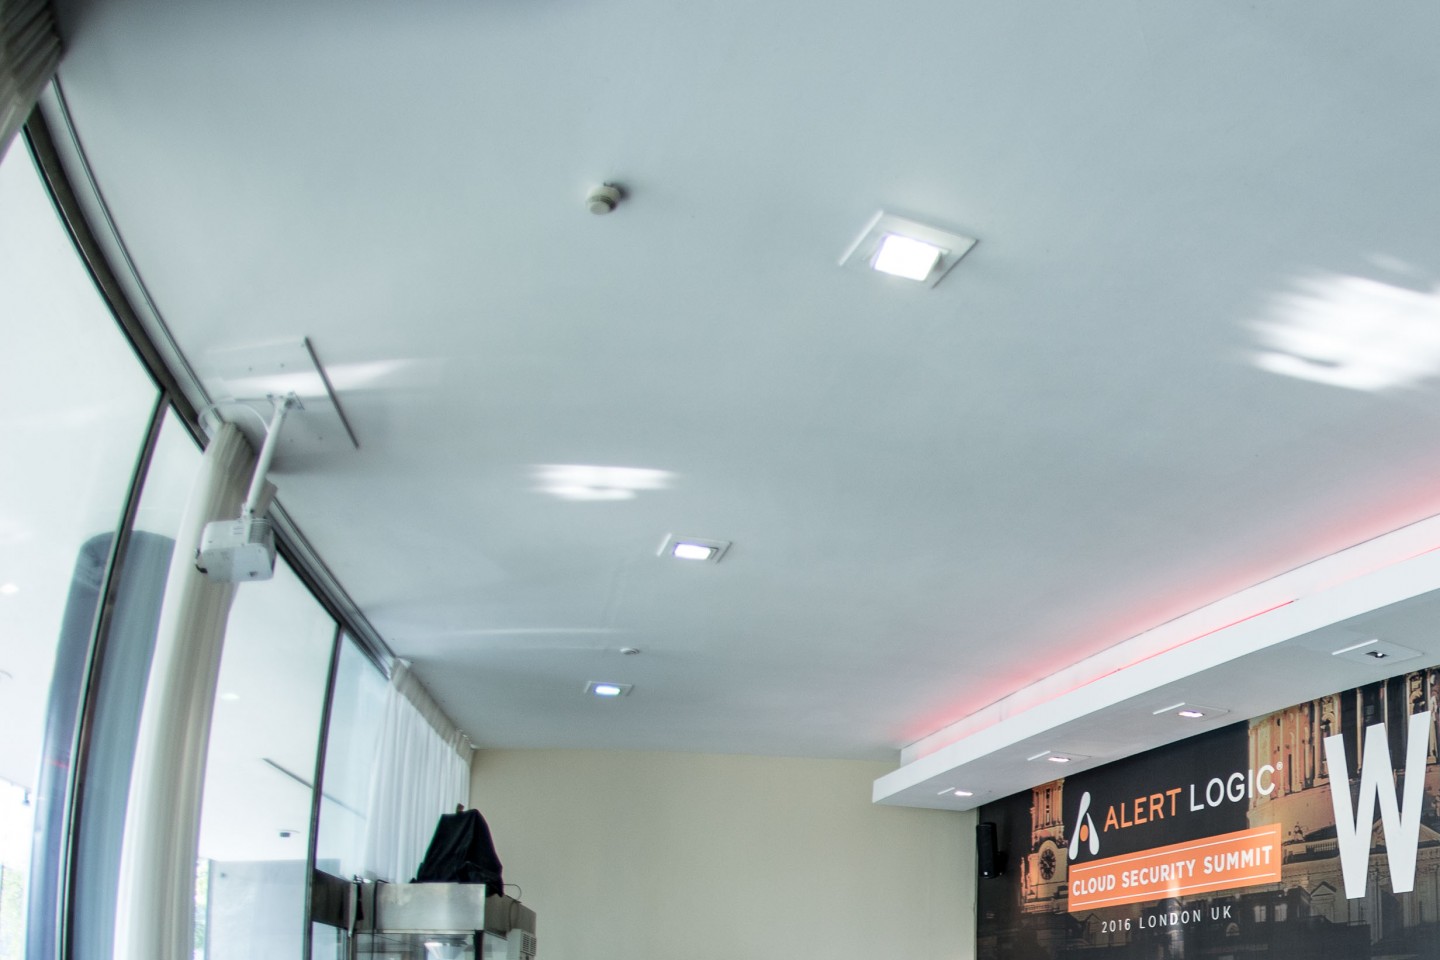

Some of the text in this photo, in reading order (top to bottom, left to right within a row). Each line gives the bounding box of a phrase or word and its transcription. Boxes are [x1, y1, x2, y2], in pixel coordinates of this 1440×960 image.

[1104, 787, 1182, 832] ALERT
[1072, 845, 1273, 897] CLOUD SECURITY SUMMIT
[1101, 904, 1232, 933] 2016 LONDON UK
